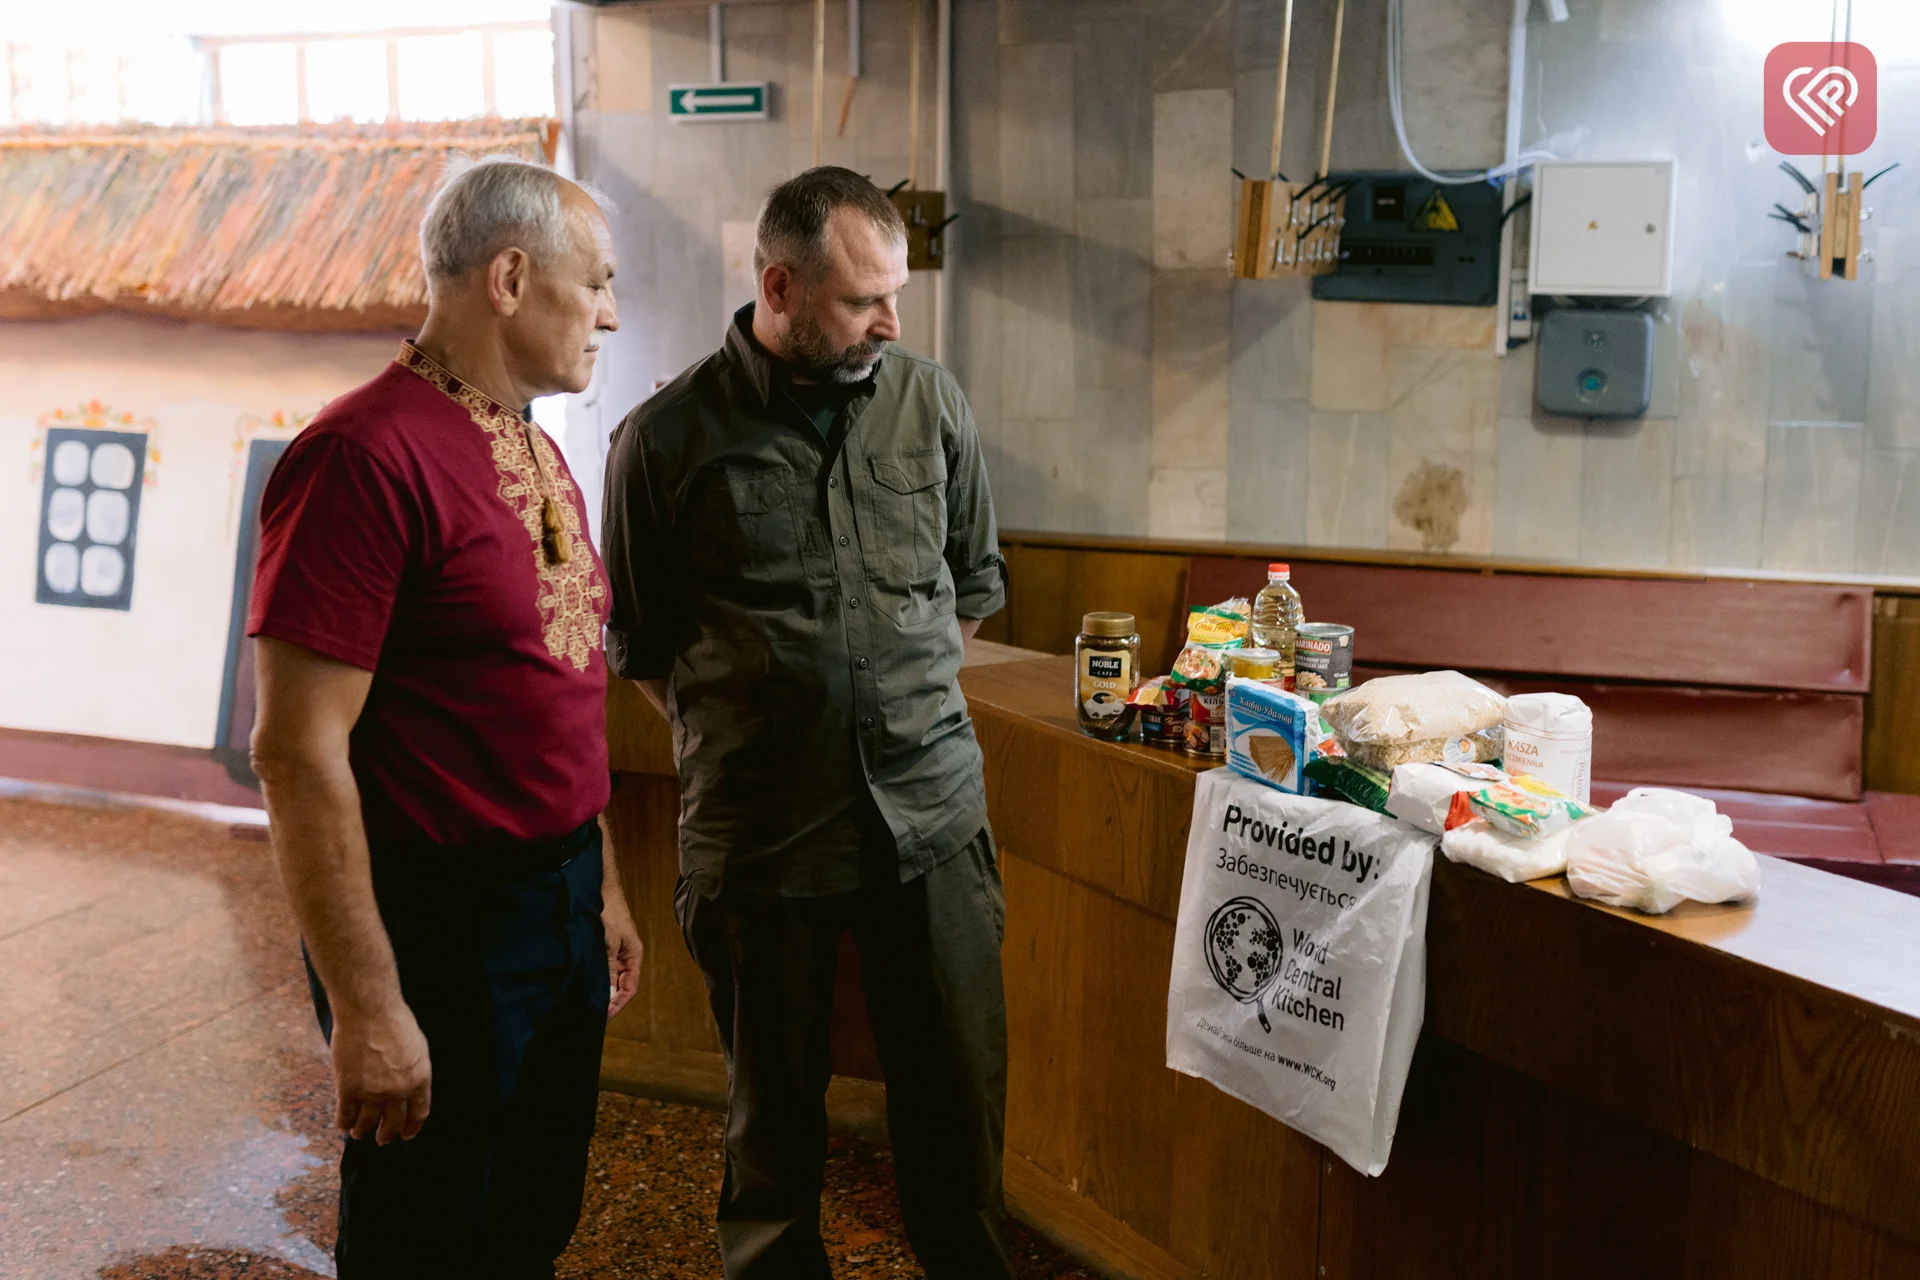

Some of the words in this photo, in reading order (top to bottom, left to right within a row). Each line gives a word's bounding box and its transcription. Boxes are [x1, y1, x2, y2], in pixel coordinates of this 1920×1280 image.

[1091, 660, 1119, 669] NOBLE
[1093, 681, 1116, 689] GOLD
[1508, 740, 1539, 757] KASZA
[1222, 804, 1336, 866] Provided
[1340, 840, 1382, 883] by:
[1284, 958, 1342, 1001] Central
[1271, 985, 1345, 1031] Kitchen
[1196, 1016, 1233, 1044] Дізнайес
[1233, 1036, 1263, 1057] більше
[1264, 1049, 1276, 1061] на
[1277, 1054, 1337, 1092] www.WCK.org
